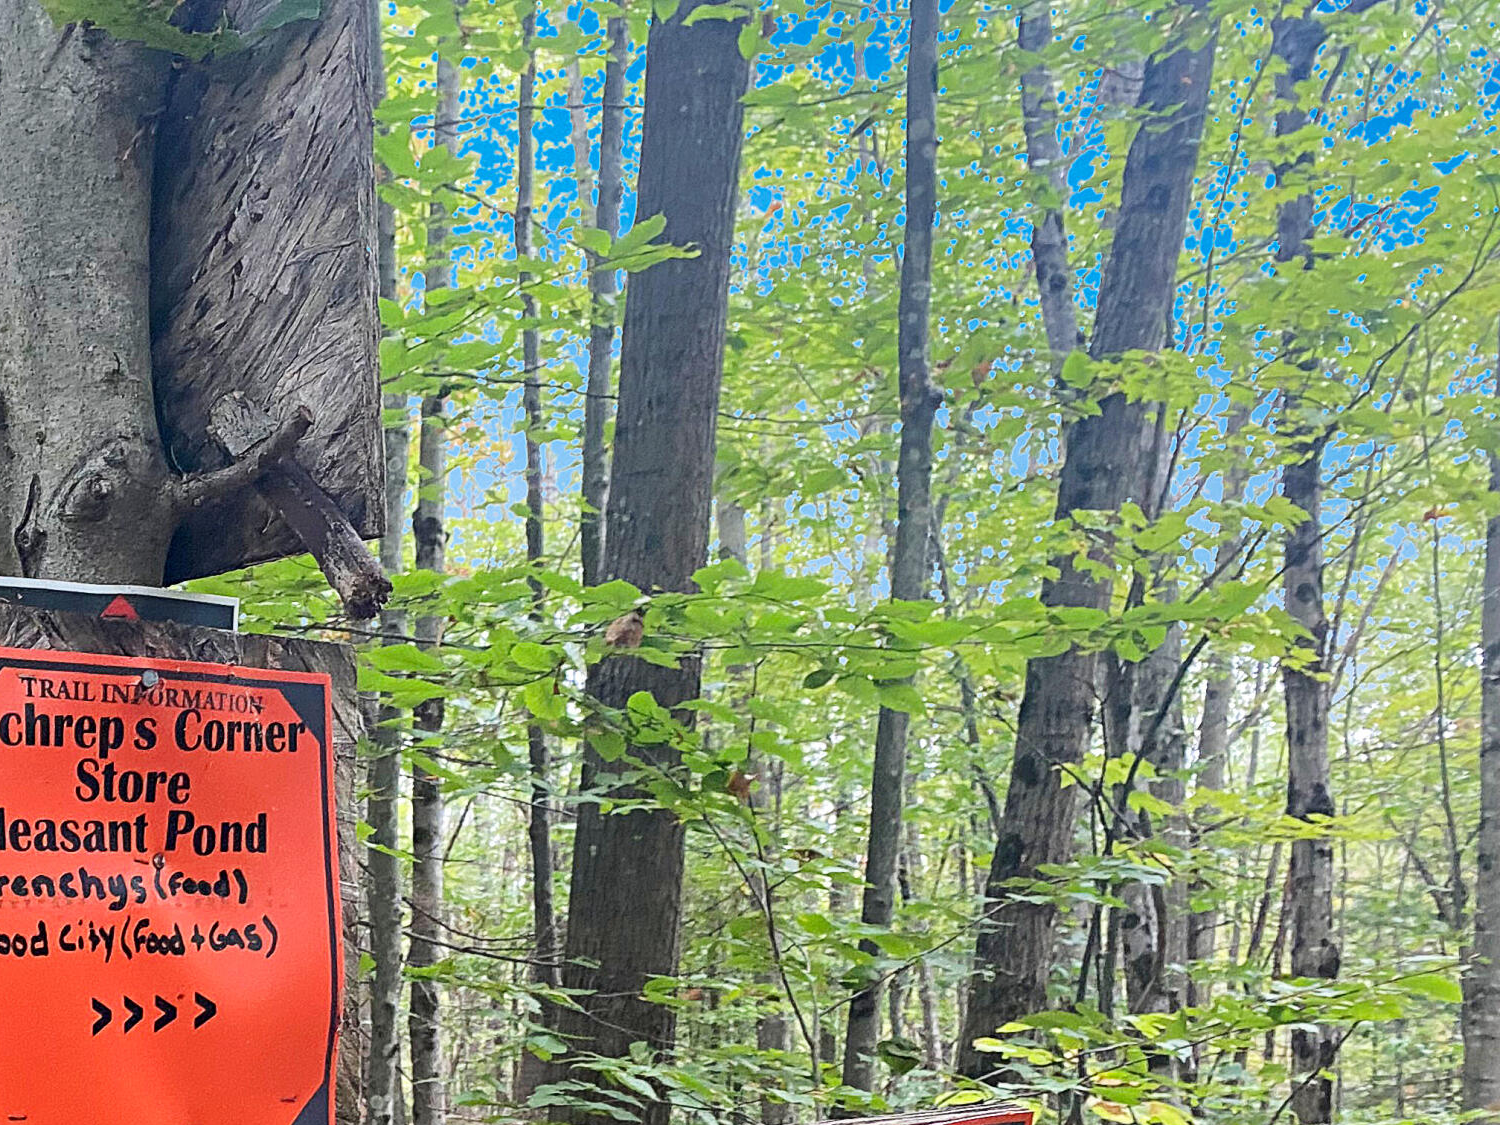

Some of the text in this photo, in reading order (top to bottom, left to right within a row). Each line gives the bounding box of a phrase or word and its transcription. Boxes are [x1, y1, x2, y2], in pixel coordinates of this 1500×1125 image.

[20, 677, 95, 702] TRAIL
[175, 708, 306, 753] Corner
[75, 757, 191, 804] Store
[165, 809, 268, 856] Pond
